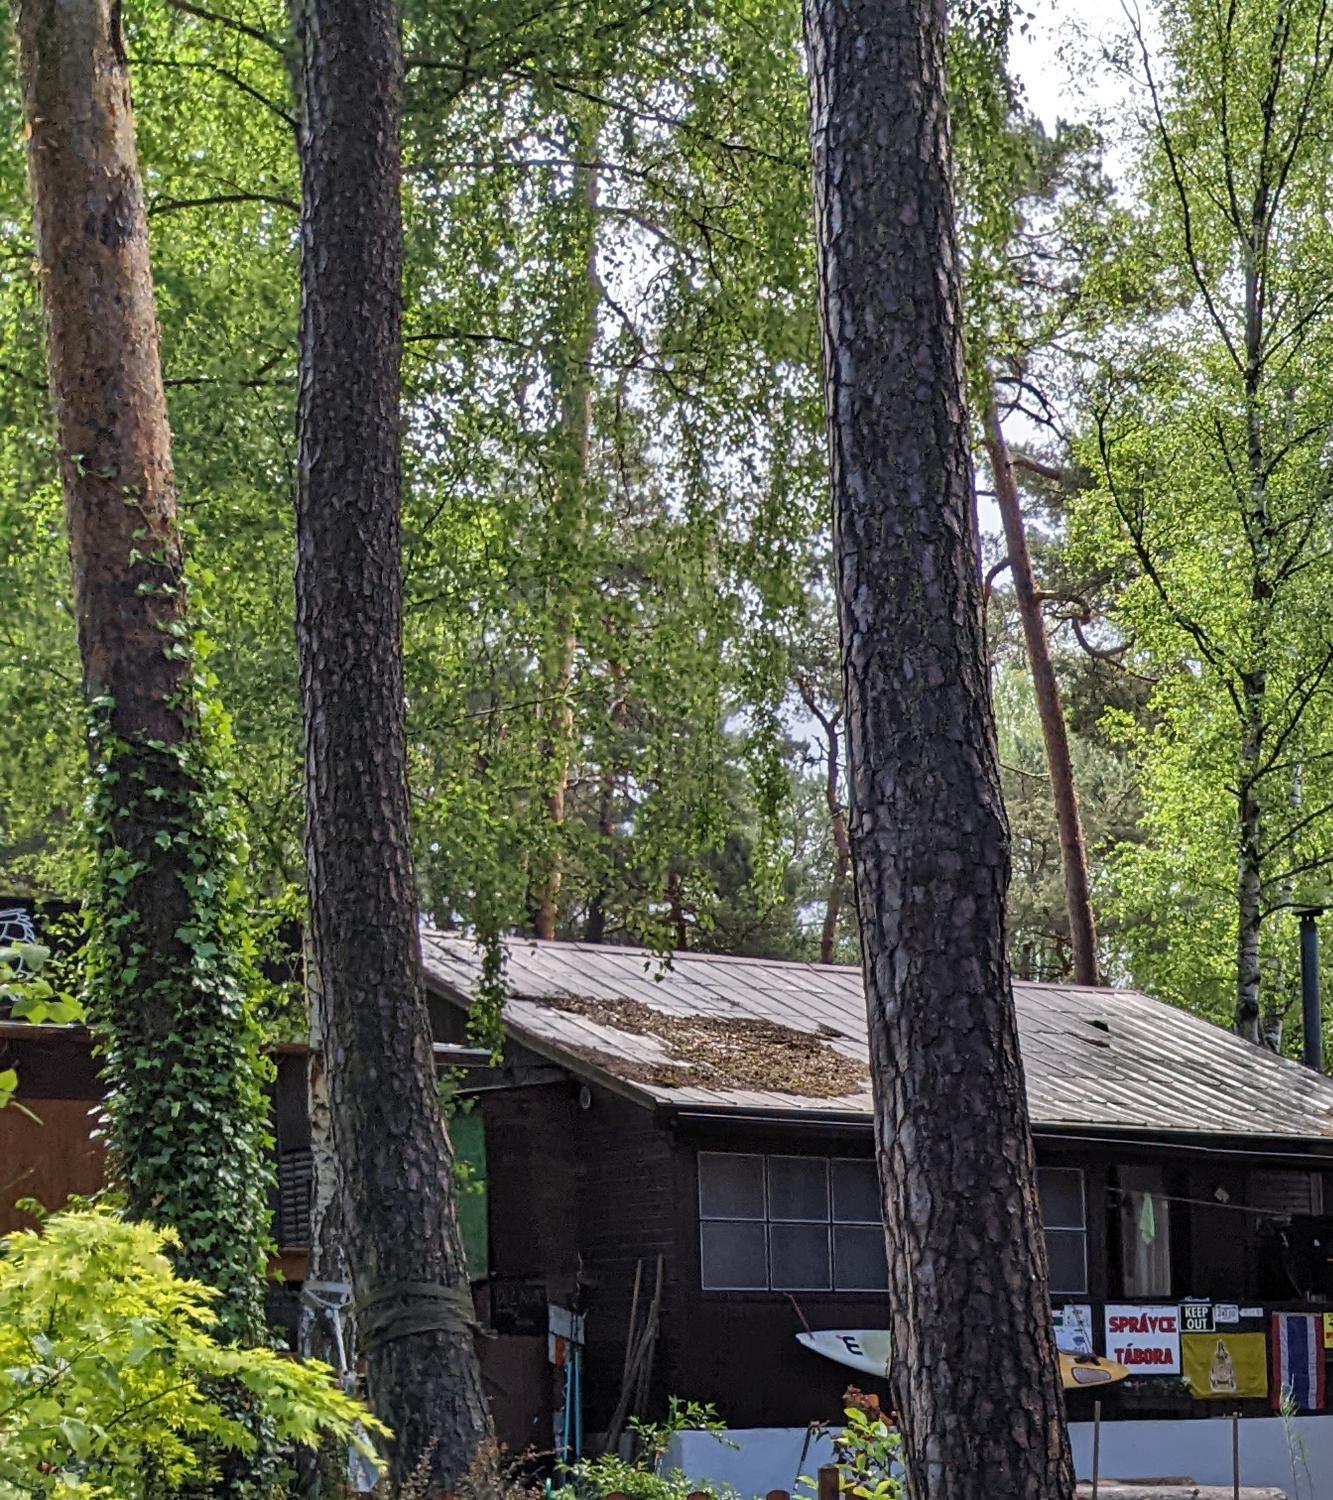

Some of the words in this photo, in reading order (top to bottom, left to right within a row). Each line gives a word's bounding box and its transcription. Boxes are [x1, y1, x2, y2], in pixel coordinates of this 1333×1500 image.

[1184, 1307, 1209, 1318] KEEP
[1109, 1313, 1177, 1334] SPRÁVCE
[1186, 1318, 1208, 1330] OUT
[1114, 1342, 1173, 1365] TÁBORA
